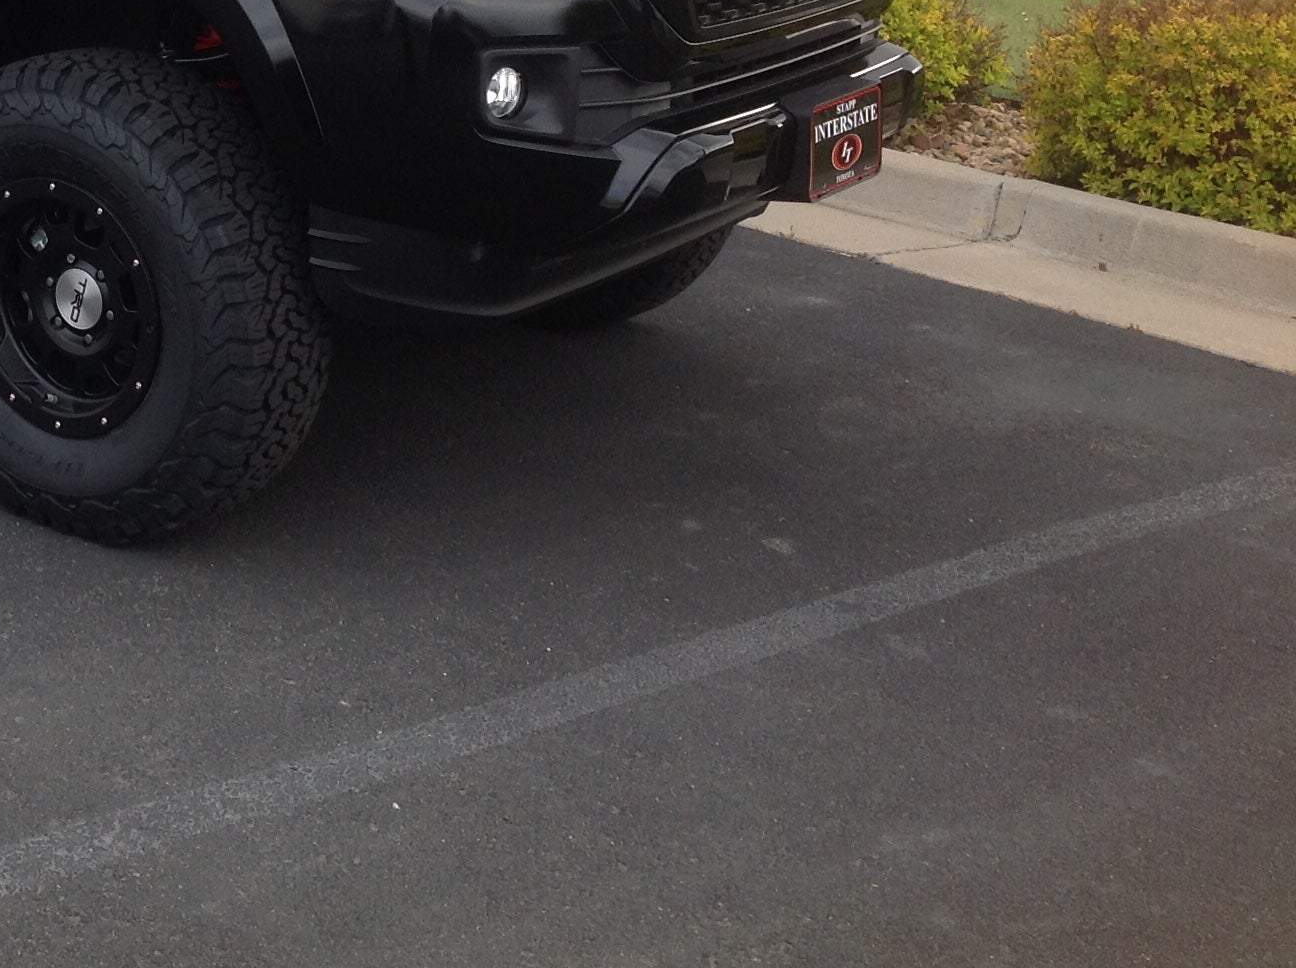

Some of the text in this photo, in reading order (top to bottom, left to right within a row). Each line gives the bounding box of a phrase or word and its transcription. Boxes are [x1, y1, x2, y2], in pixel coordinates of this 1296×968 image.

[814, 103, 878, 144] INTERSTATE
[836, 99, 857, 114] STAPP
[70, 278, 88, 323] TRD
